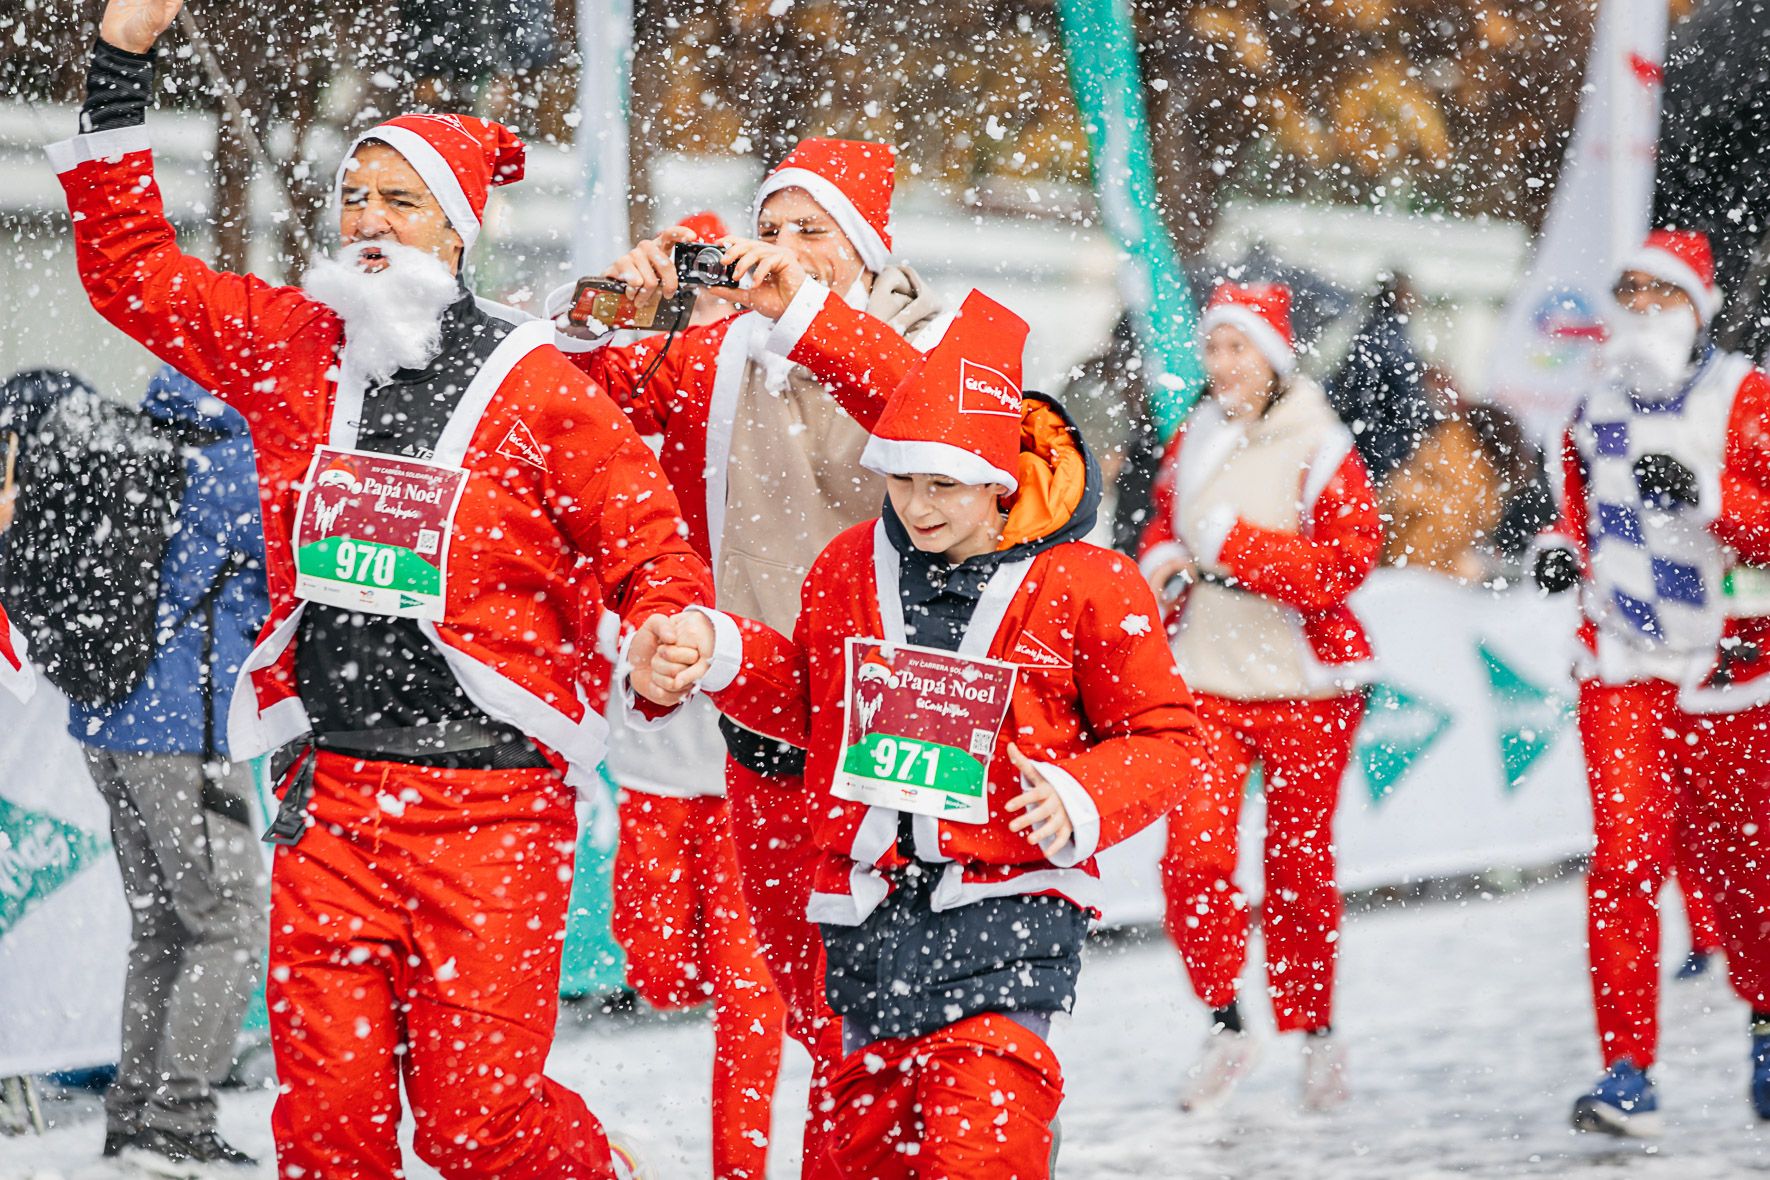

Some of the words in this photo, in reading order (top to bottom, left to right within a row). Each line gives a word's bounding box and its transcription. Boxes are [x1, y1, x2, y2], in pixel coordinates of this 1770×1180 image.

[362, 477, 402, 502] Papá
[404, 483, 444, 504] Noel
[335, 541, 397, 587] 970
[898, 670, 947, 697] Papá
[950, 679, 996, 704] Noel
[908, 659, 919, 667] XIV
[920, 660, 949, 672] CARRERA
[983, 673, 994, 681] DE
[873, 738, 941, 786] 971
